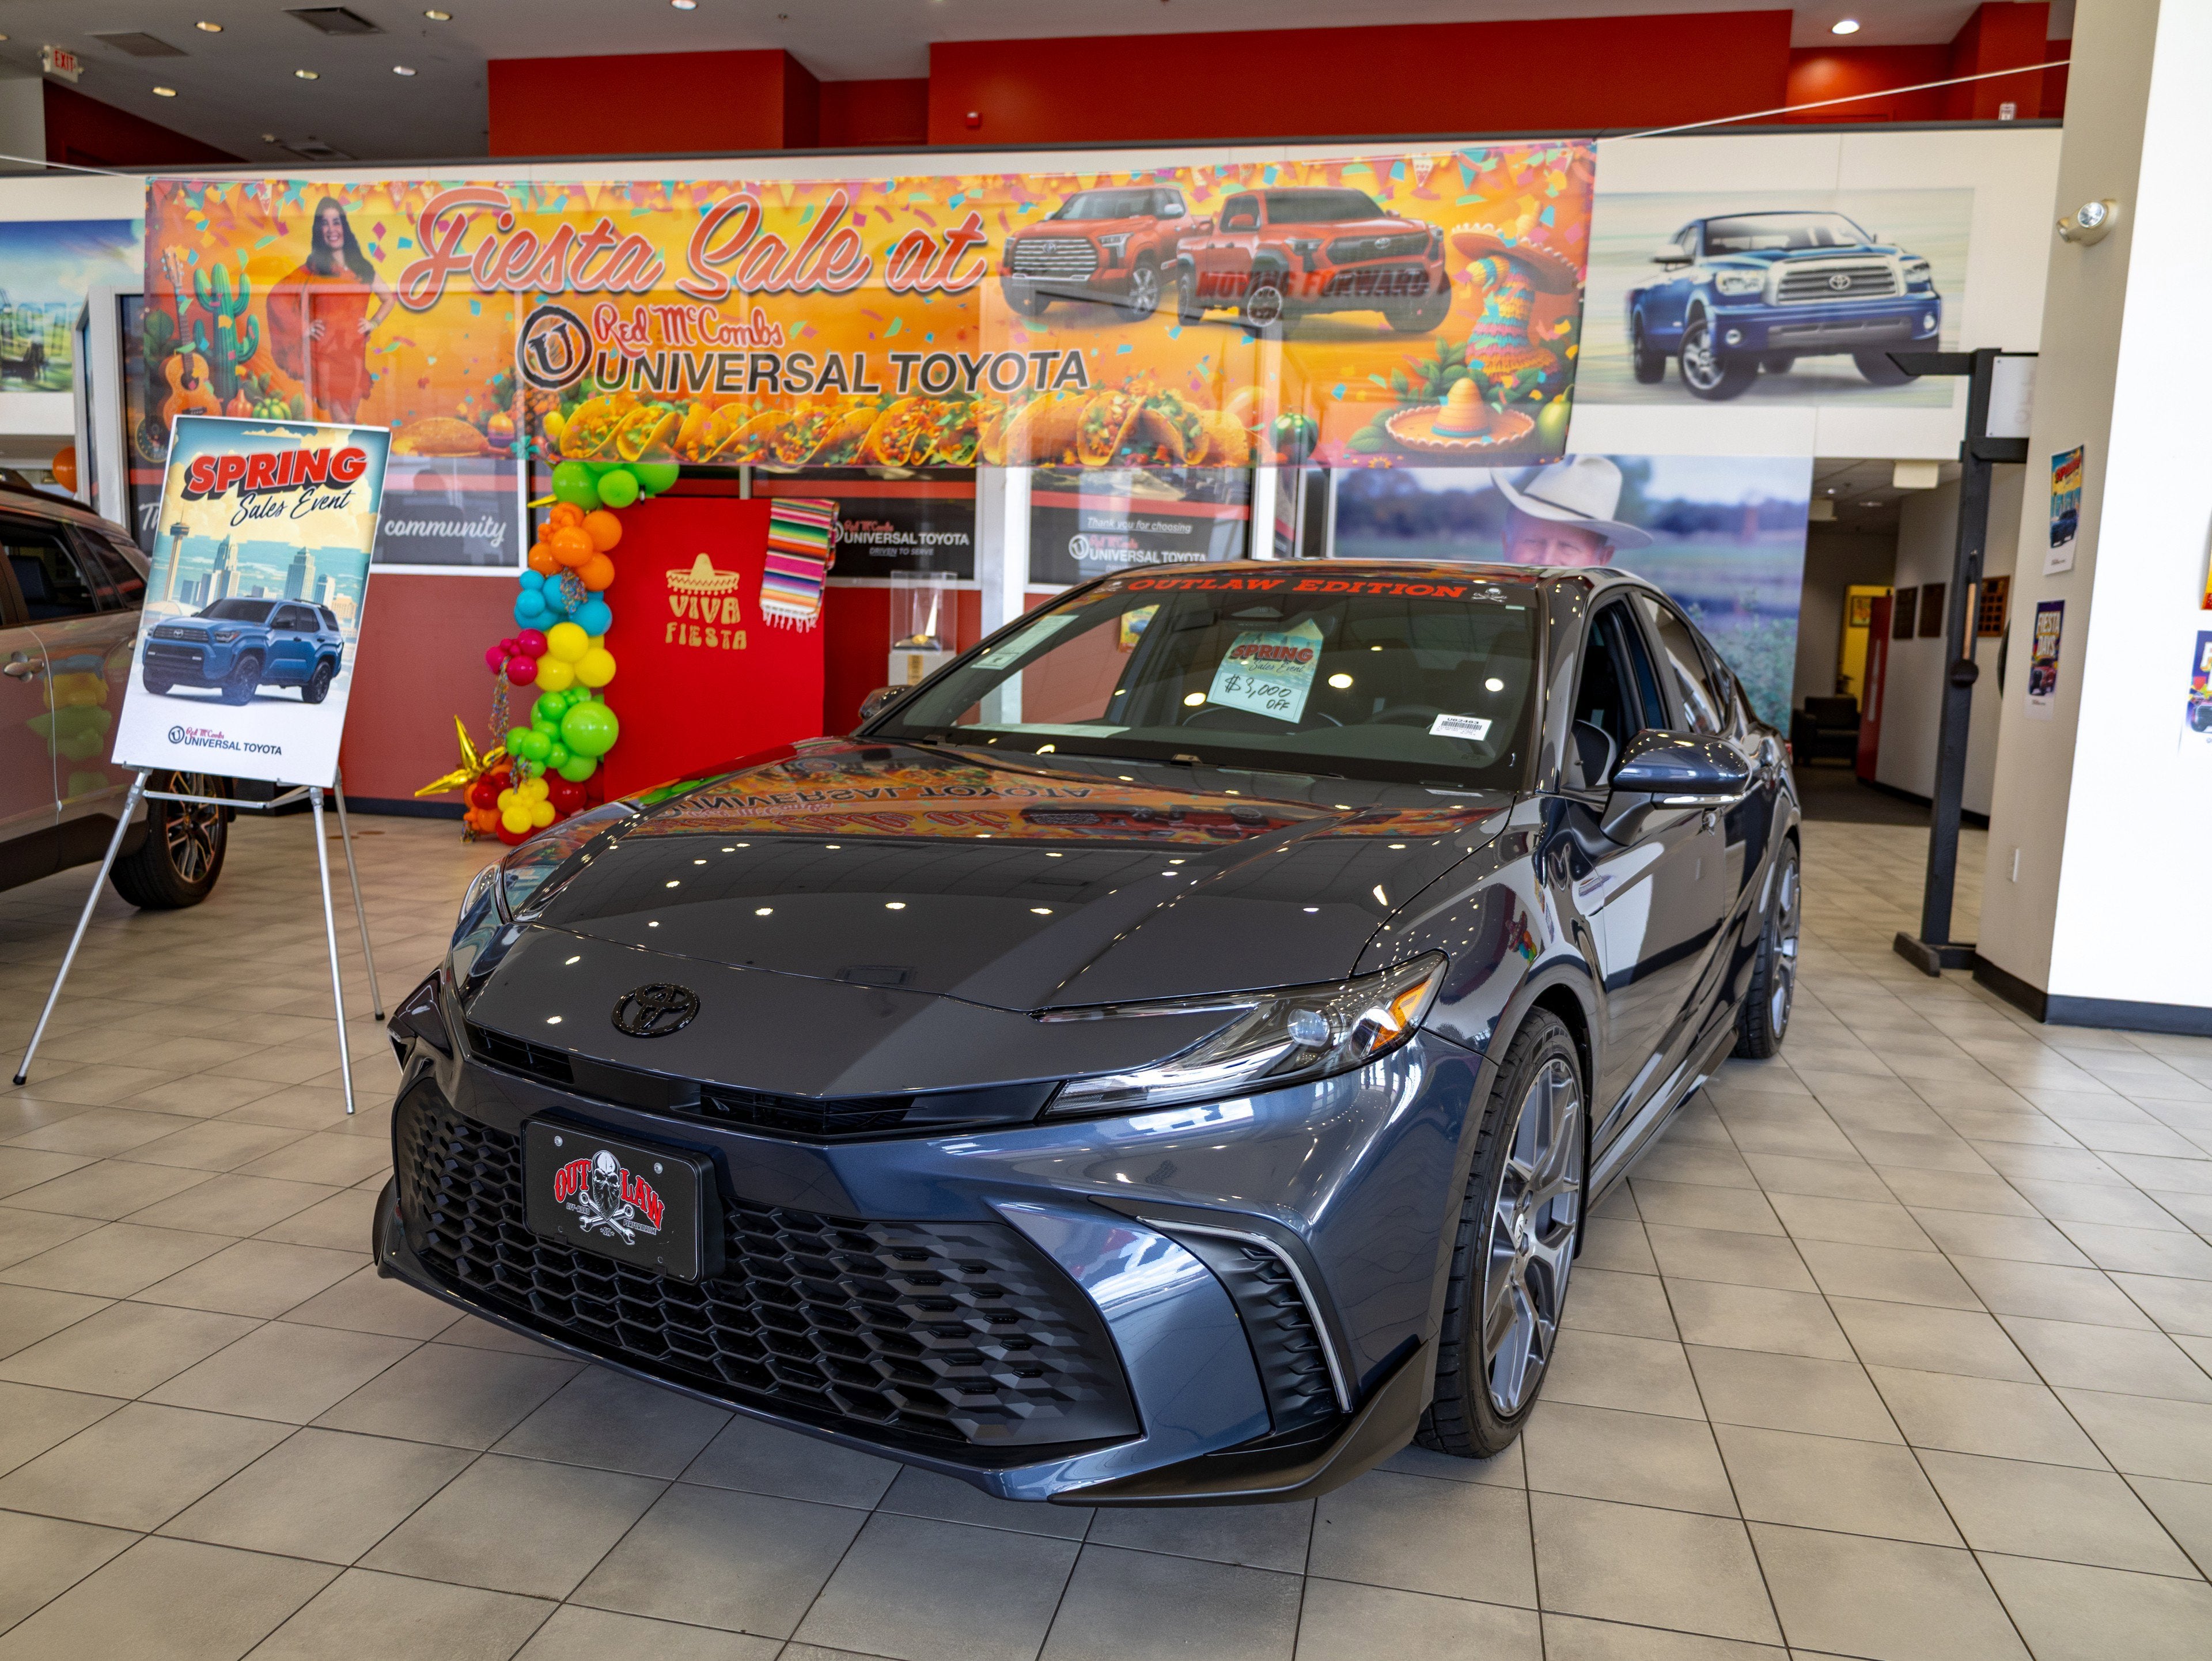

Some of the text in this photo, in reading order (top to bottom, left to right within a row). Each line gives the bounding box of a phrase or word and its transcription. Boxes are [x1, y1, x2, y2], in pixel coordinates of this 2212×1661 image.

[54, 49, 74, 72] EXIT
[397, 186, 987, 309] Fiesta Sale at
[592, 302, 785, 358] Red McCombs
[594, 349, 1090, 394] UNIVERSAL TOYOTA
[184, 447, 368, 497] SPRING
[230, 486, 357, 527] Sales Event
[384, 515, 506, 547] community
[1088, 517, 1193, 534] Thank you for choosing
[844, 531, 969, 546] UNIVERSAL TOYOTA
[869, 547, 897, 557] DRIVEN
[1089, 549, 1206, 563] UNIVERSAL TOYOTA
[1128, 578, 1468, 598] OUTLAW EDITION
[669, 595, 741, 625] VIVA
[2037, 612, 2061, 635] FIESTA
[665, 621, 747, 650] FIESTA
[1230, 644, 1314, 664] SPRING
[1249, 660, 1305, 673] Sales Event
[1266, 699, 1290, 710] OFF
[185, 727, 198, 739] Red
[184, 736, 282, 755] UNIVERSAL TOYOTA
[554, 1159, 665, 1231] OUT LAW
[566, 1202, 590, 1216] OFF-ROAD
[623, 1219, 657, 1235] PERFORMANCE
